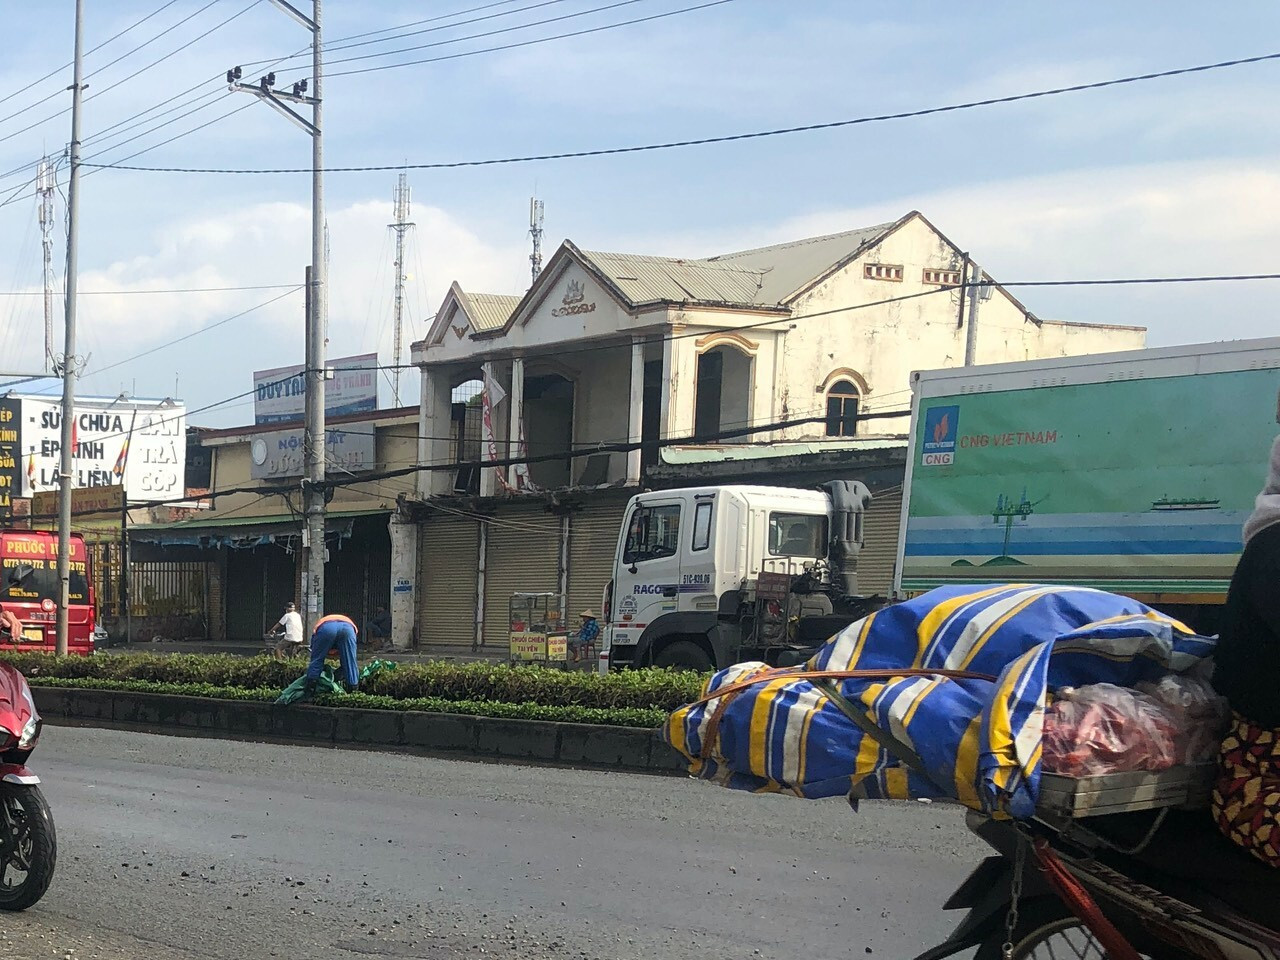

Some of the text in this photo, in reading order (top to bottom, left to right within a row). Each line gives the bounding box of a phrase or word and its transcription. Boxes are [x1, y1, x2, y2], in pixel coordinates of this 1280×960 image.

[960, 430, 1058, 448] CNG VIETNAM
[925, 454, 950, 465] CNG
